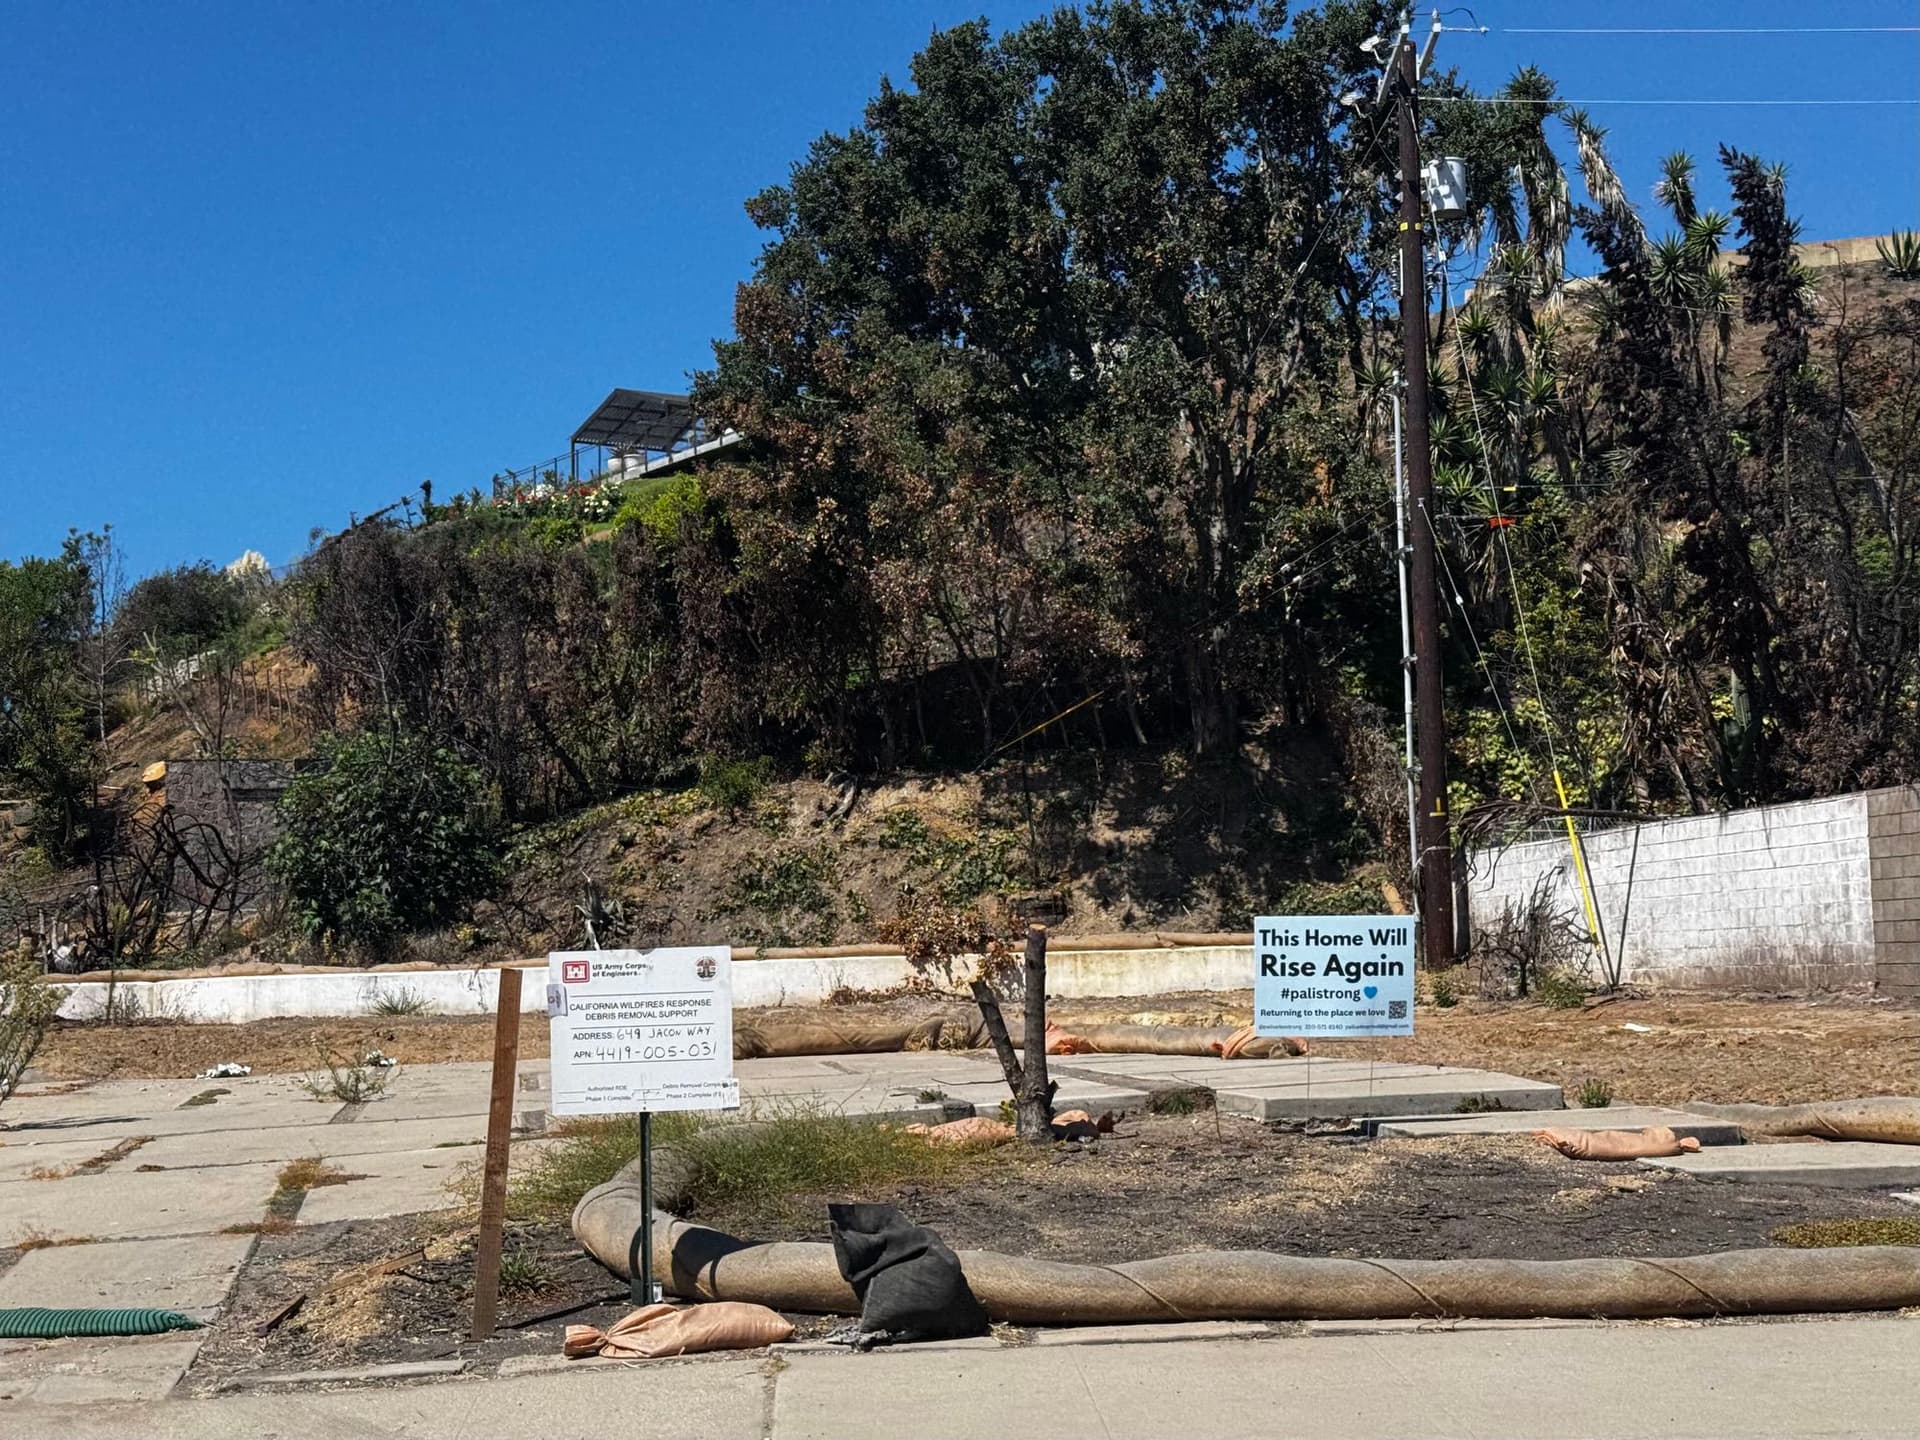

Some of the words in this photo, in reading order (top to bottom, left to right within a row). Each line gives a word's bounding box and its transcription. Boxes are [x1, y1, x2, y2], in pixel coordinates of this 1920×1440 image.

[1259, 929, 1299, 946] This
[1305, 929, 1363, 946] Home
[1368, 928, 1407, 945] Will
[1261, 954, 1316, 977] Rise
[1323, 953, 1404, 983] Again
[1281, 987, 1361, 1002] #palistrong
[569, 1002, 618, 1011] CALIFORNIA
[619, 1000, 665, 1010] WILDFIRES
[666, 999, 712, 1008] RESPONSE
[585, 1012, 616, 1021] DEBRIS
[618, 1010, 657, 1020] REMOVAL
[659, 1009, 698, 1018] SUPPORT
[1260, 1009, 1302, 1018] Returning
[1331, 1009, 1353, 1018] place
[617, 1028, 640, 1040] 649
[687, 1026, 711, 1036] WAY
[574, 1050, 592, 1058] APN:
[596, 1041, 717, 1060] 4419-005-031
